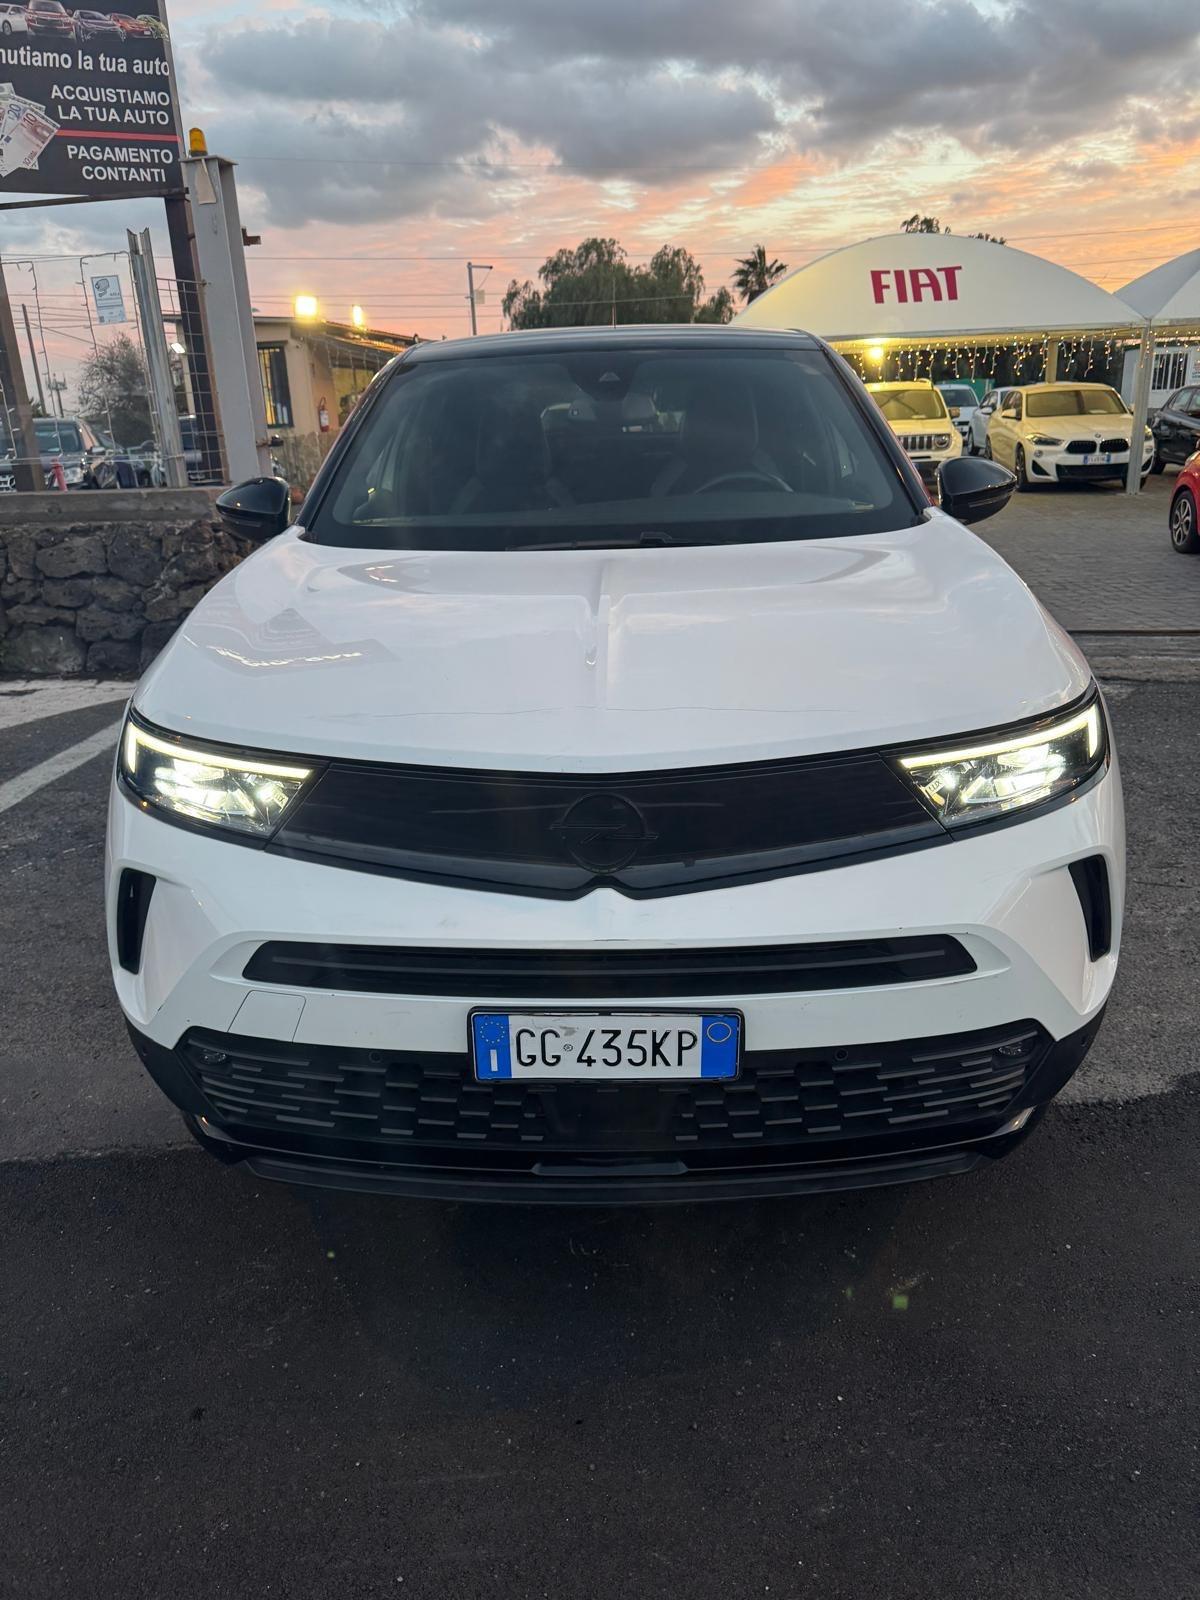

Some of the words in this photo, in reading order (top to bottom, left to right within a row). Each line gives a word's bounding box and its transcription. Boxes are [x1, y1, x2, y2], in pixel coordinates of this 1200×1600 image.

[78, 49, 93, 70] la
[99, 53, 127, 73] tua
[133, 57, 169, 76] auto
[51, 84, 170, 106] ACQUISTIAMO
[57, 105, 82, 120] LA
[84, 106, 120, 122] TUA
[124, 109, 169, 125] AUTO
[67, 145, 173, 164] PAGAMENTO
[82, 165, 166, 182] CONTANTI
[870, 266, 962, 304] FIAT
[515, 1028, 562, 1067] GG
[576, 1028, 698, 1067] 435KP
